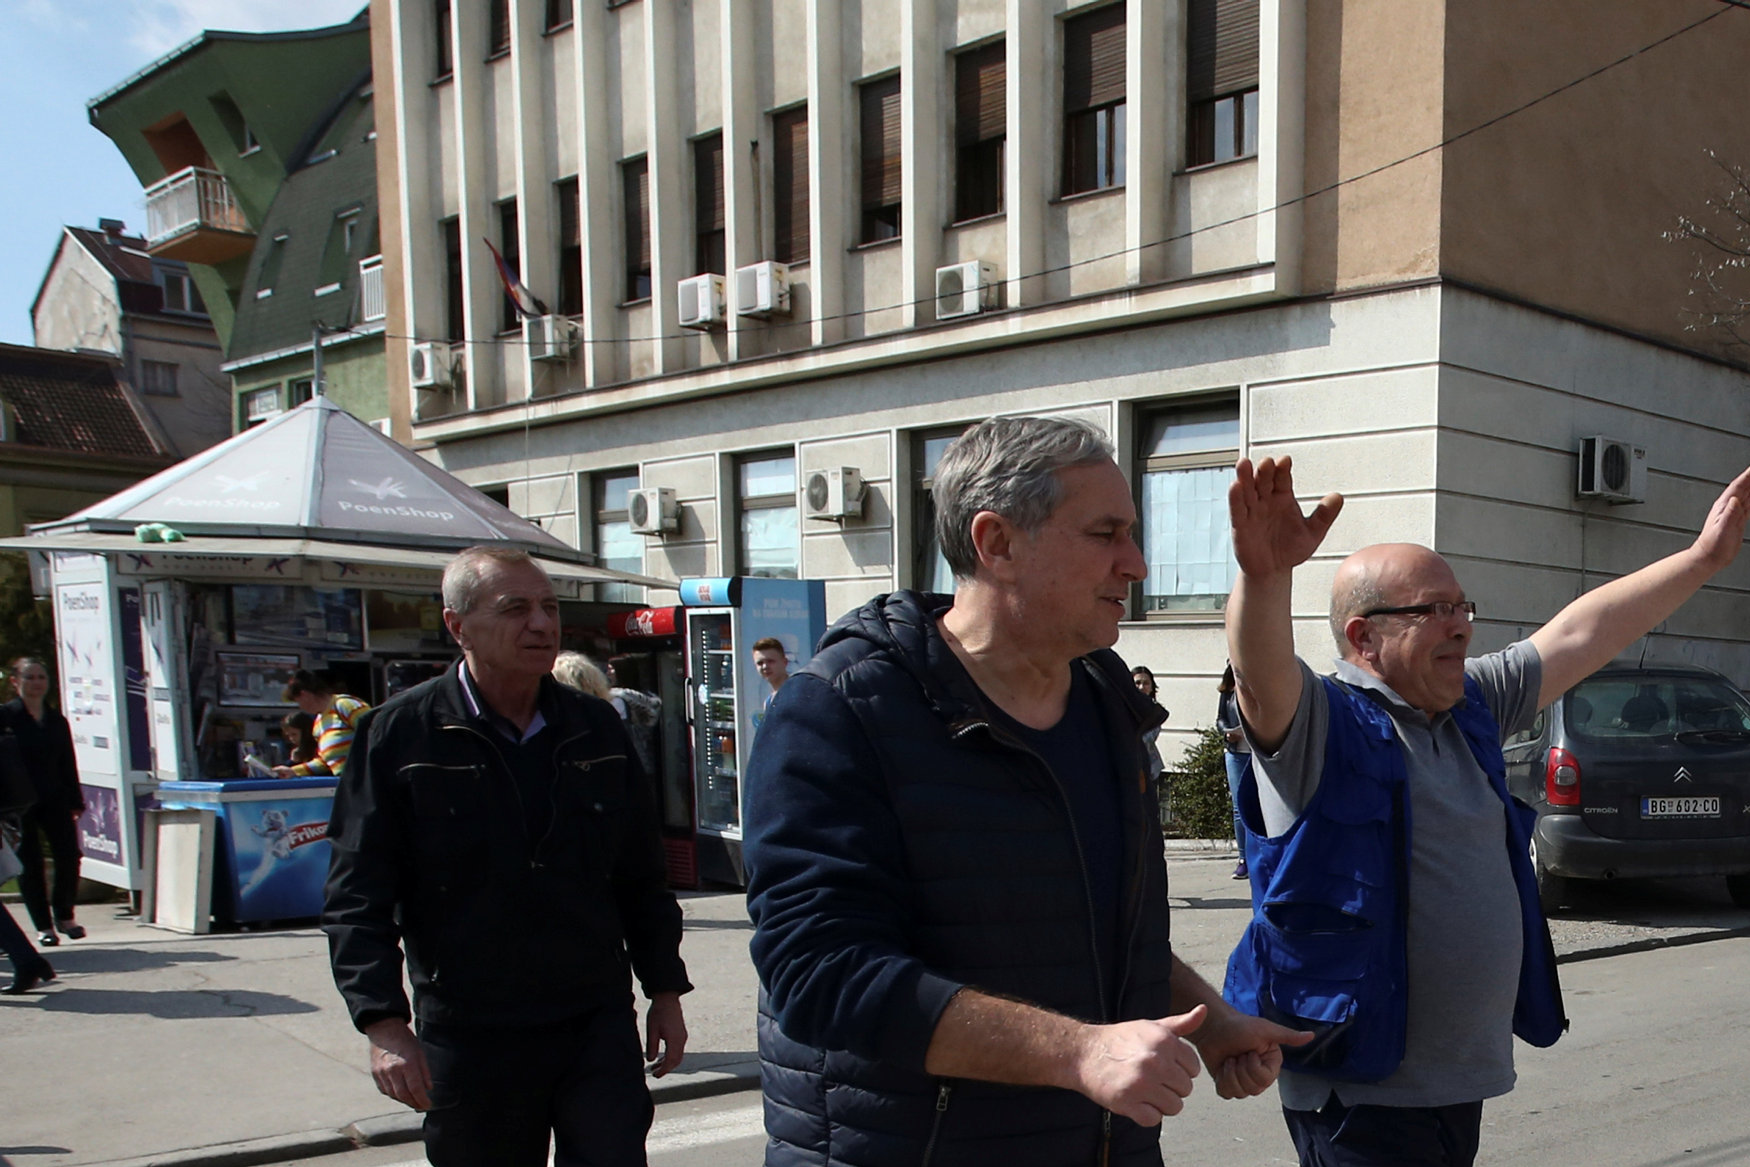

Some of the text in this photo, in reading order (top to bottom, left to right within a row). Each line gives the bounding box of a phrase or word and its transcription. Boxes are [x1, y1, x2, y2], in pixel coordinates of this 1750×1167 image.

[338, 500, 454, 521] PoenShop
[1651, 800, 1666, 813] BG
[82, 830, 118, 859] PoenShop
[287, 824, 330, 845] Friko
